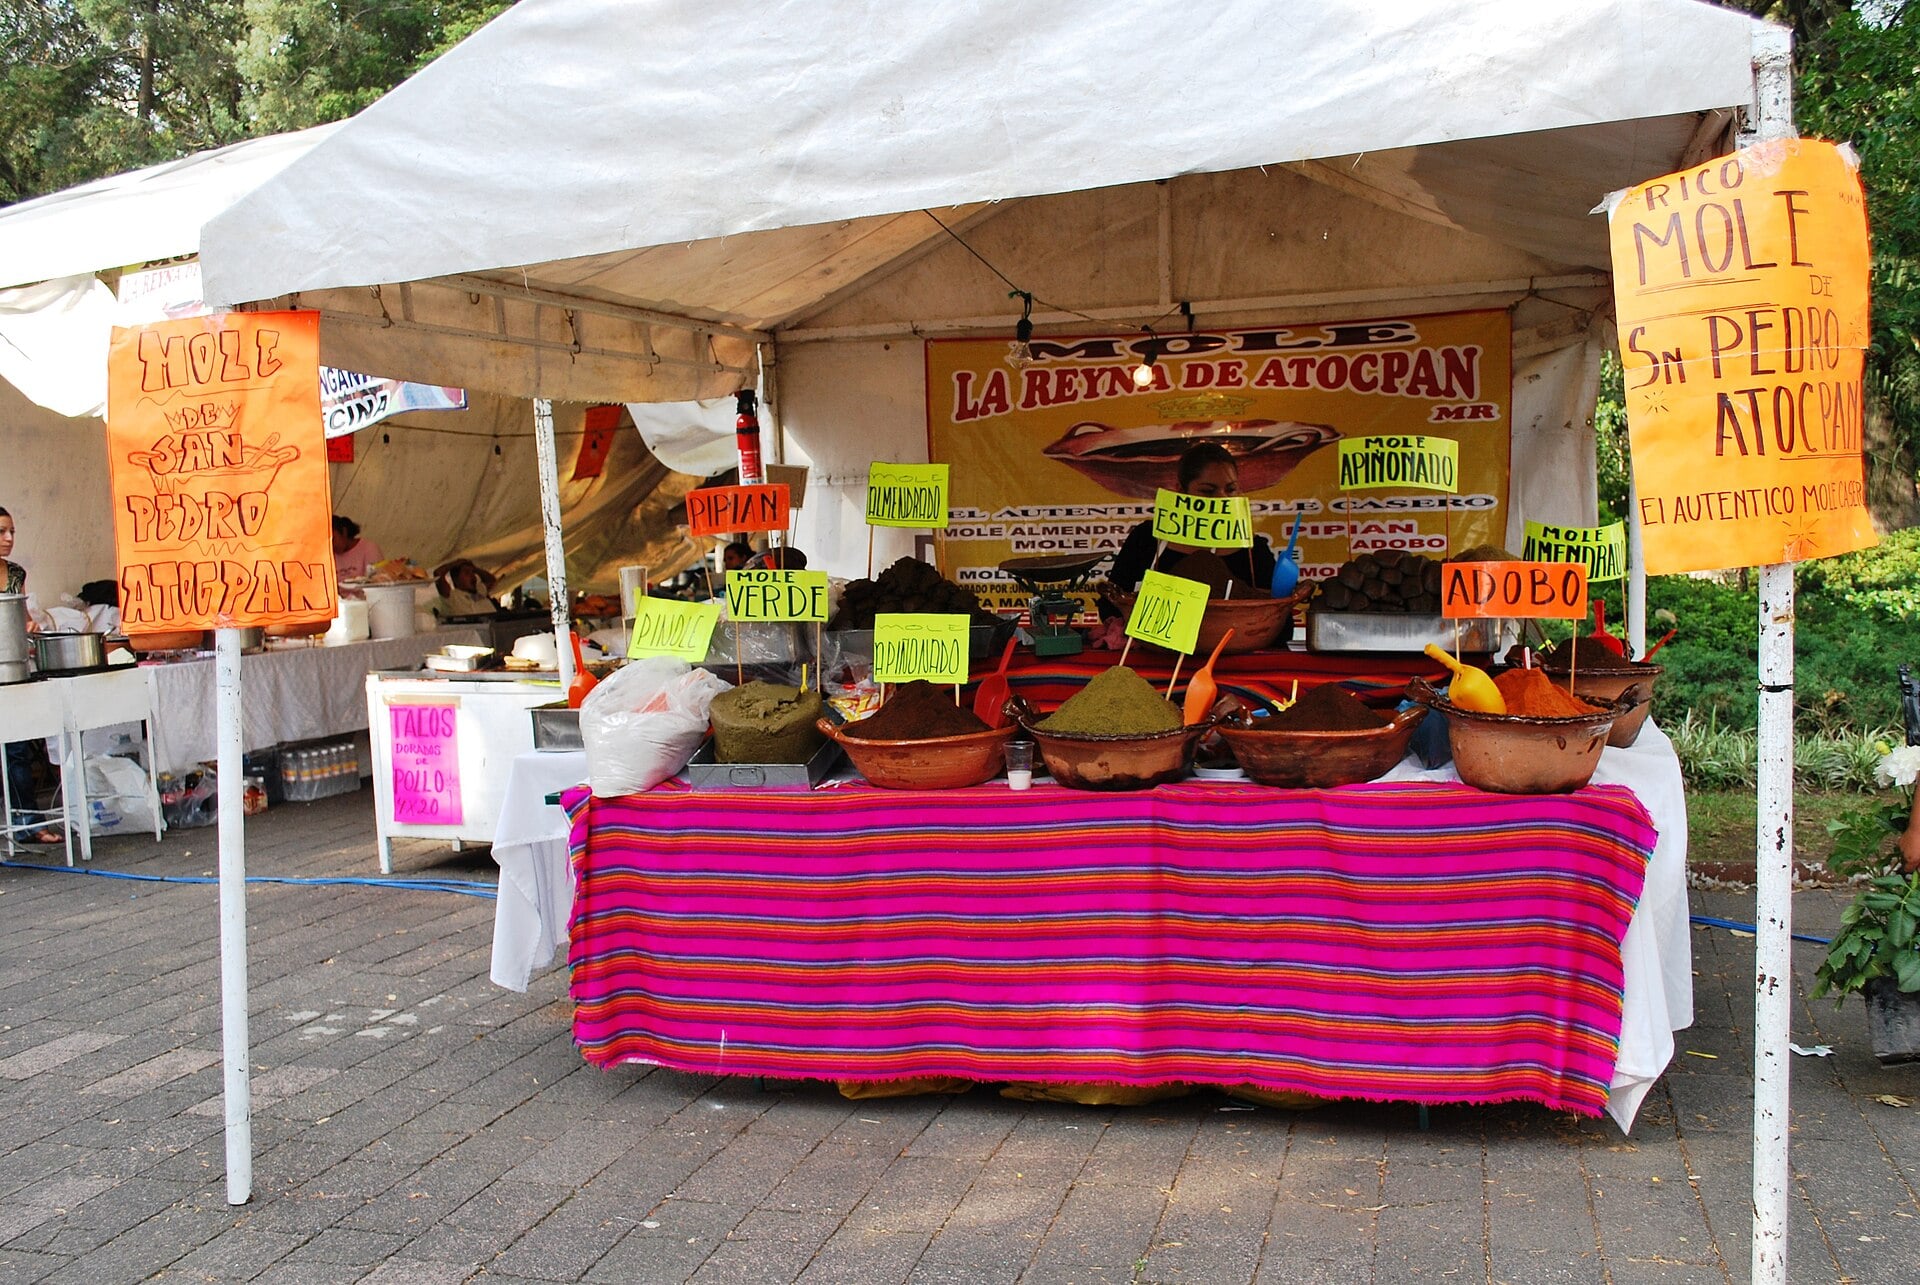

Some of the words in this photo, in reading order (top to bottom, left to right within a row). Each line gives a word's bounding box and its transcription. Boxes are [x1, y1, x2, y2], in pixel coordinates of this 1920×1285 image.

[1645, 159, 1744, 211] RICO
[1633, 190, 1813, 286] MOLE
[1809, 274, 1833, 297] DE
[1009, 323, 1416, 360] MOLE
[1702, 307, 1840, 379] PEDRO
[138, 329, 282, 393] MOLE
[955, 371, 1009, 421] LA
[1021, 366, 1170, 409] REYNA
[1183, 361, 1243, 388] DE
[1255, 347, 1478, 399] ATOCPAN
[183, 403, 217, 430] DE
[322, 395, 388, 430] CINA
[1433, 405, 1495, 421] MR
[1716, 380, 1860, 456] ATOCPAN
[149, 433, 244, 475] SAN
[1365, 437, 1426, 449] MOLE
[127, 491, 269, 543] PEDRO
[689, 490, 777, 528] PIPIAN
[868, 485, 940, 519] ALMENDRADO
[949, 509, 986, 519] EL
[1332, 497, 1494, 511] CASERO
[1176, 495, 1231, 514] MOLE
[1674, 486, 1794, 524] AUTENTICO
[945, 526, 1003, 537] MOLE
[1156, 508, 1250, 540] ESPECIAL
[1286, 523, 1414, 535] PIPIAN
[1542, 526, 1603, 542] MOLE
[1015, 539, 1088, 549] MOLE
[1353, 538, 1445, 549] ADOBO
[737, 571, 794, 583] MOLE
[1447, 568, 1580, 607] ADOBO
[728, 584, 824, 618] VERDE
[1137, 594, 1182, 639] VERDE
[637, 612, 704, 649] PINOLE
[390, 708, 453, 738] TACOS
[394, 768, 444, 794] POLLO
